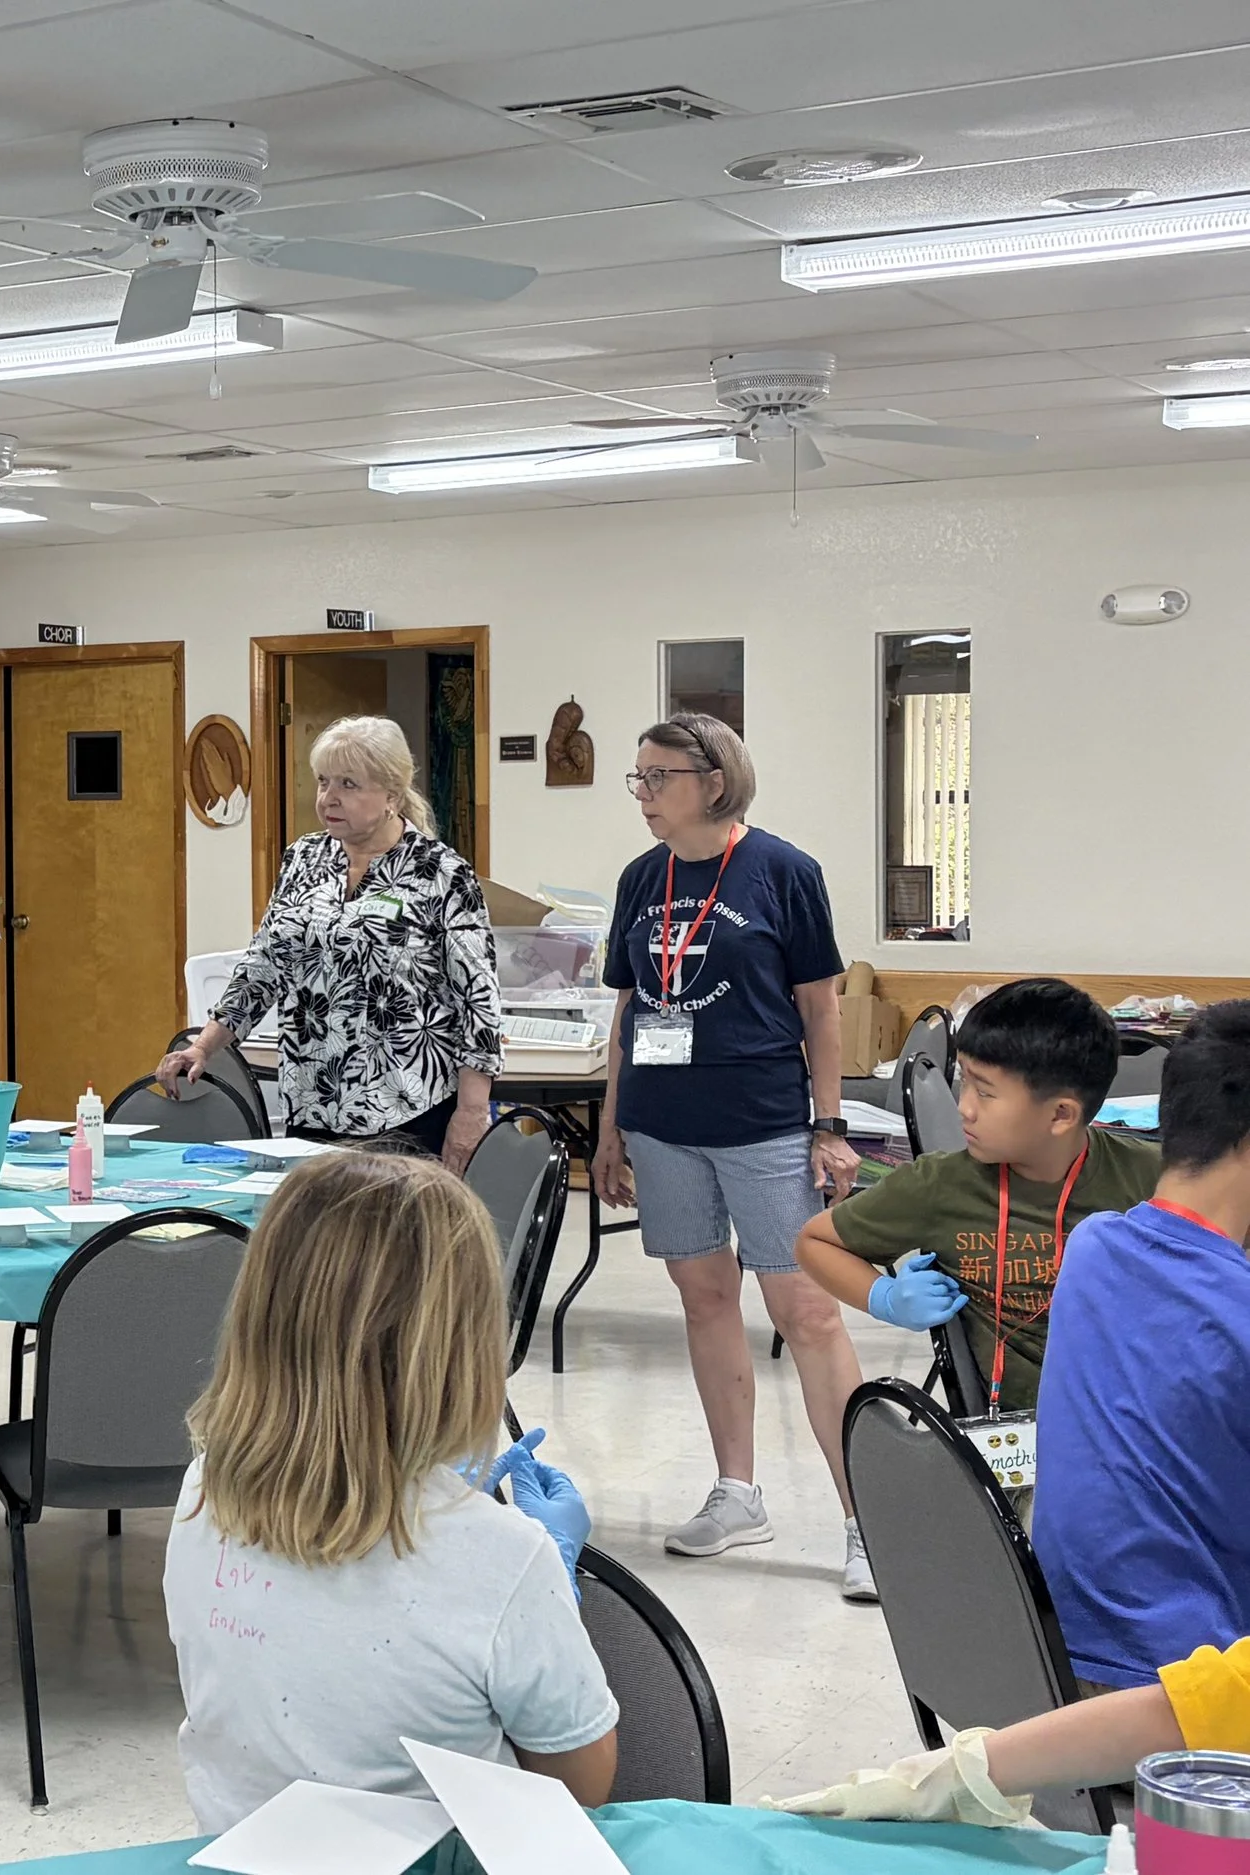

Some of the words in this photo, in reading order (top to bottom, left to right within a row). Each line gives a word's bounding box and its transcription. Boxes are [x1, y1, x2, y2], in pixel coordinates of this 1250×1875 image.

[331, 611, 362, 628] YOUTH
[713, 901, 750, 928] Assisi
[682, 979, 732, 1012] Church
[955, 1232, 1069, 1252] SINGAP
[983, 1447, 1036, 1470] moth
